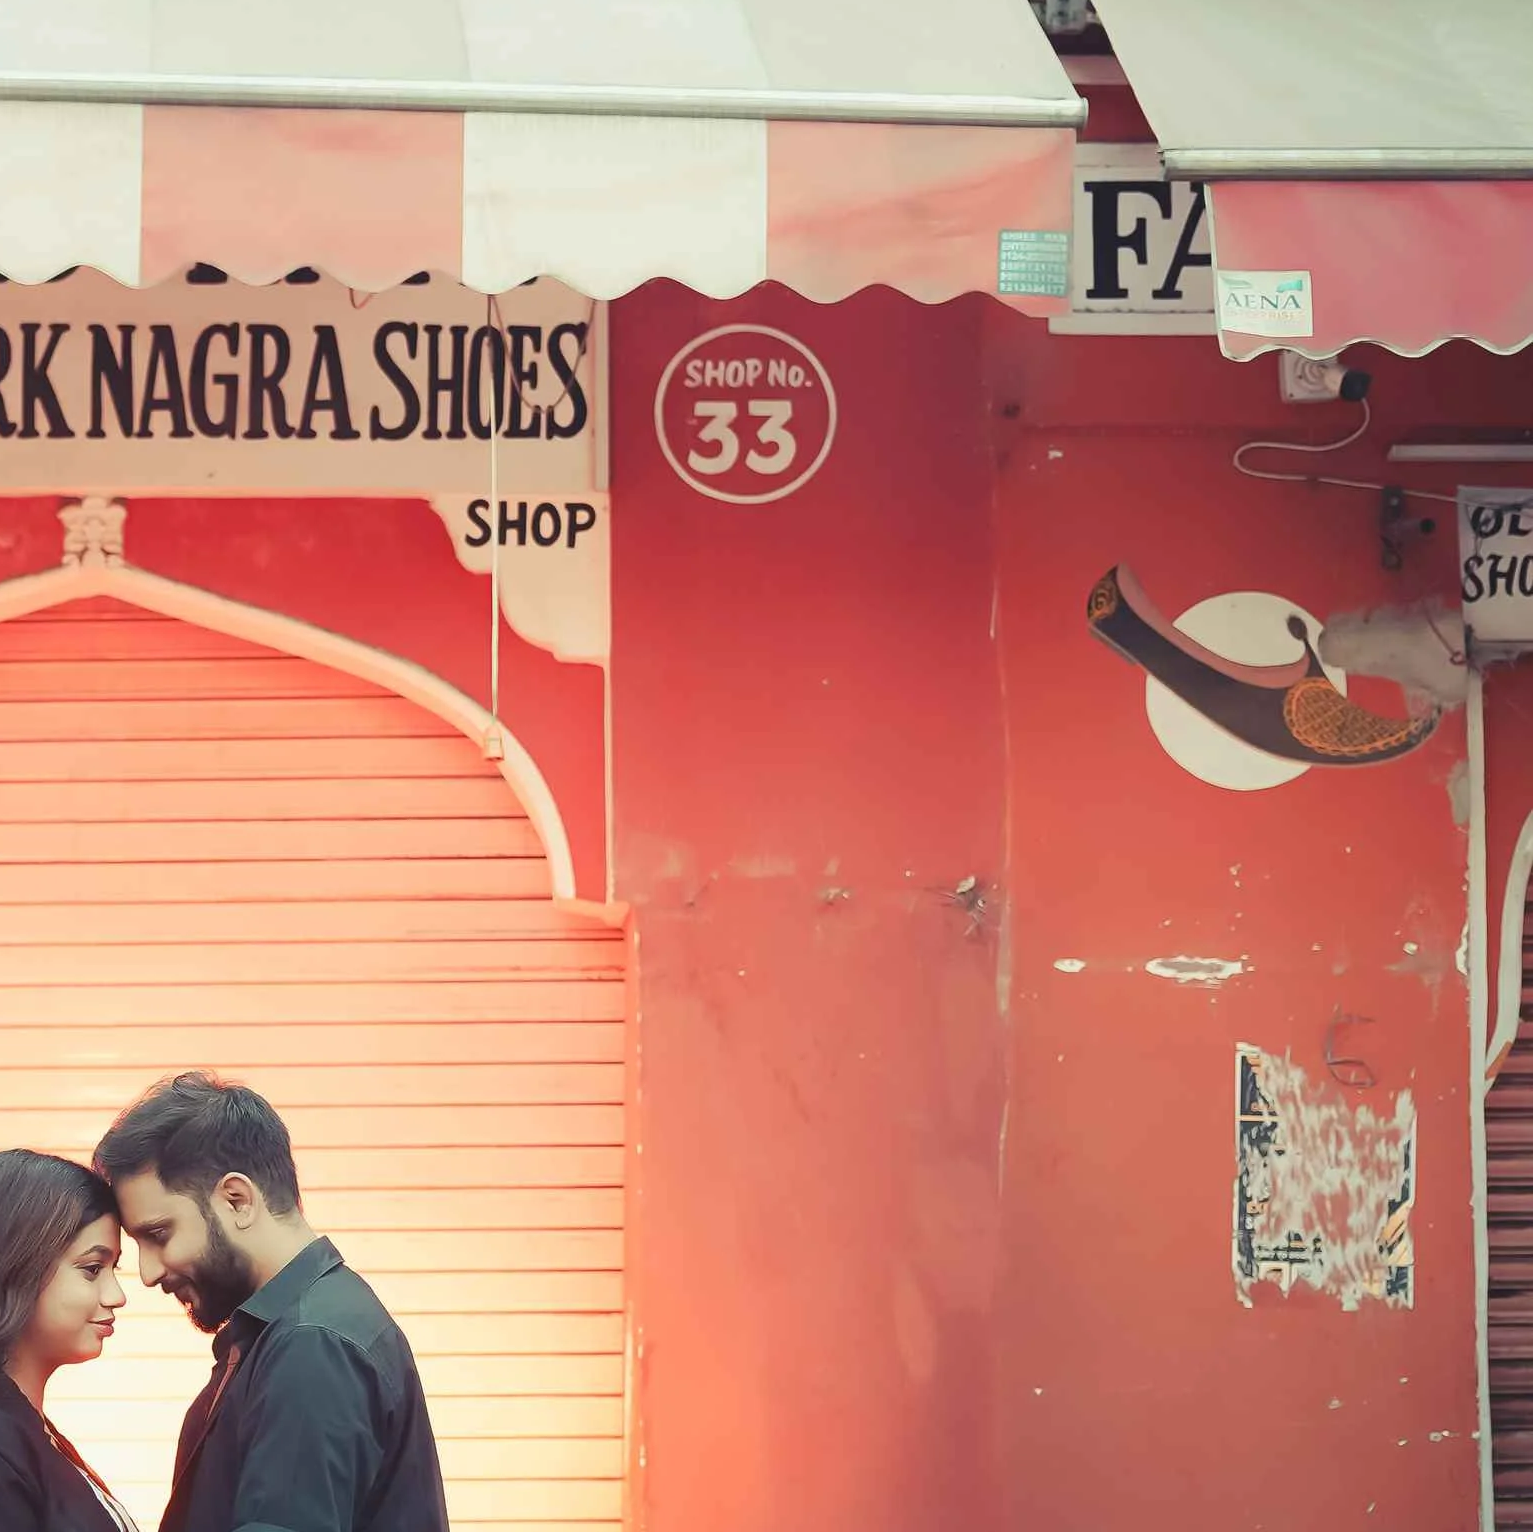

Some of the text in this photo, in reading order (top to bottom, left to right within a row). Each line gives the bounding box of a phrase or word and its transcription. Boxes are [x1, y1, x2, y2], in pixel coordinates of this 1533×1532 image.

[87, 322, 360, 438] NAGRA
[371, 322, 589, 440] SHOES
[684, 358, 813, 388] SHOP No.
[687, 400, 797, 475] 33
[465, 498, 597, 548] SHOP
